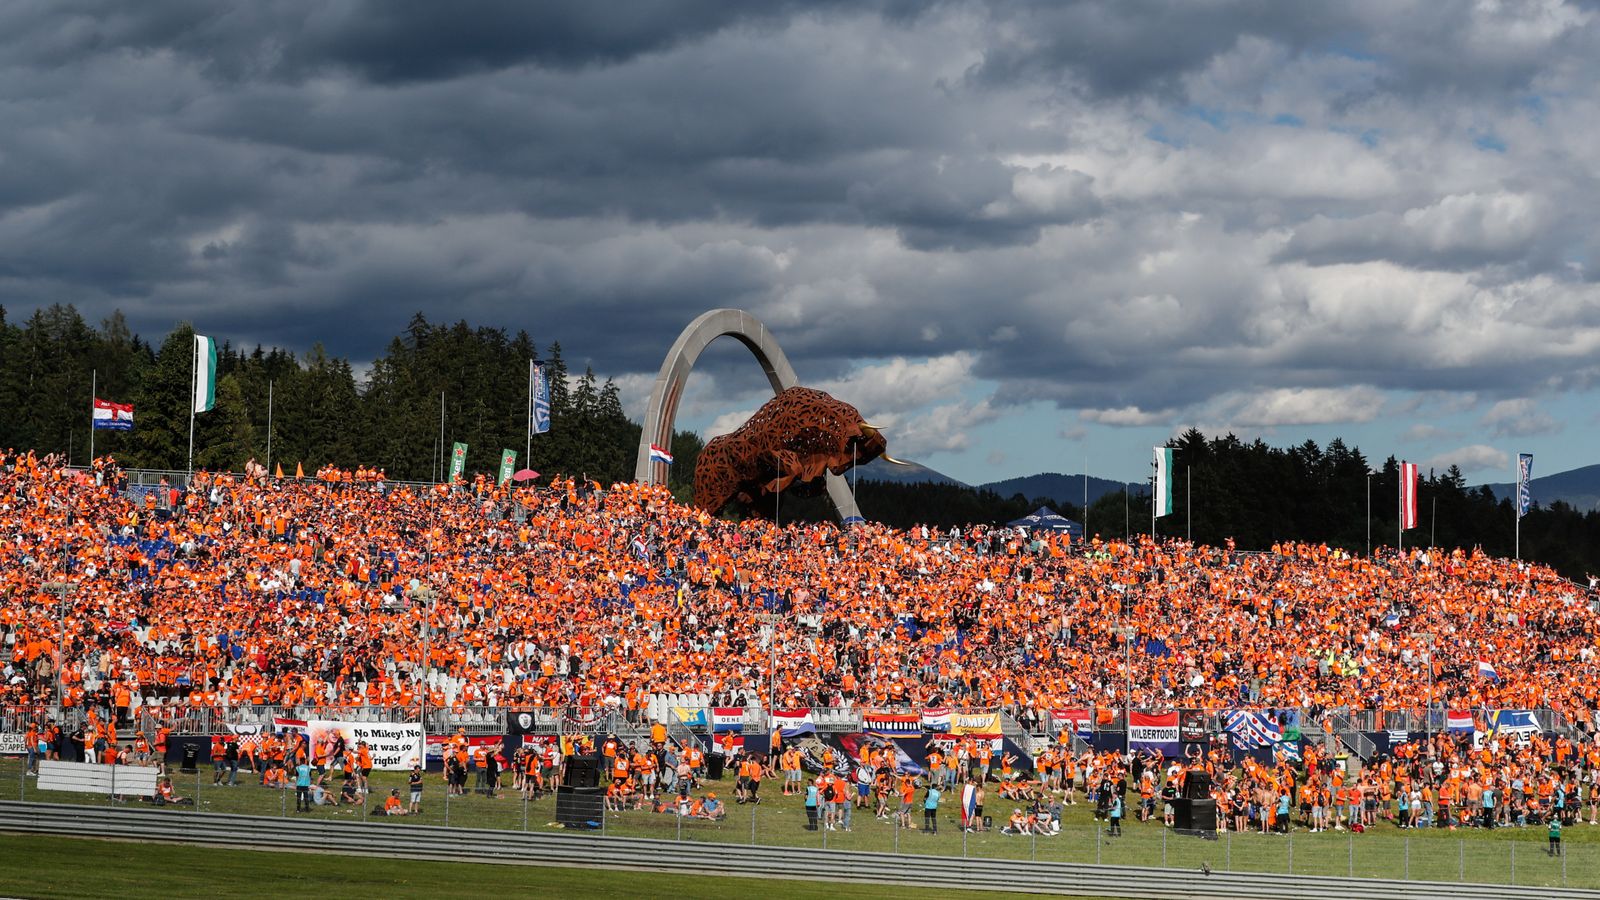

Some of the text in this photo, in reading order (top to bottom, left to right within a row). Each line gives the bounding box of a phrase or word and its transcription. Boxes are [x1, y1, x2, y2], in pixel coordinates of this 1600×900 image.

[354, 729, 420, 740] No Mikey! No
[1131, 728, 1177, 740] WILBERTOORD
[380, 744, 399, 752] was
[401, 743, 412, 751] so
[373, 757, 400, 767] right!
